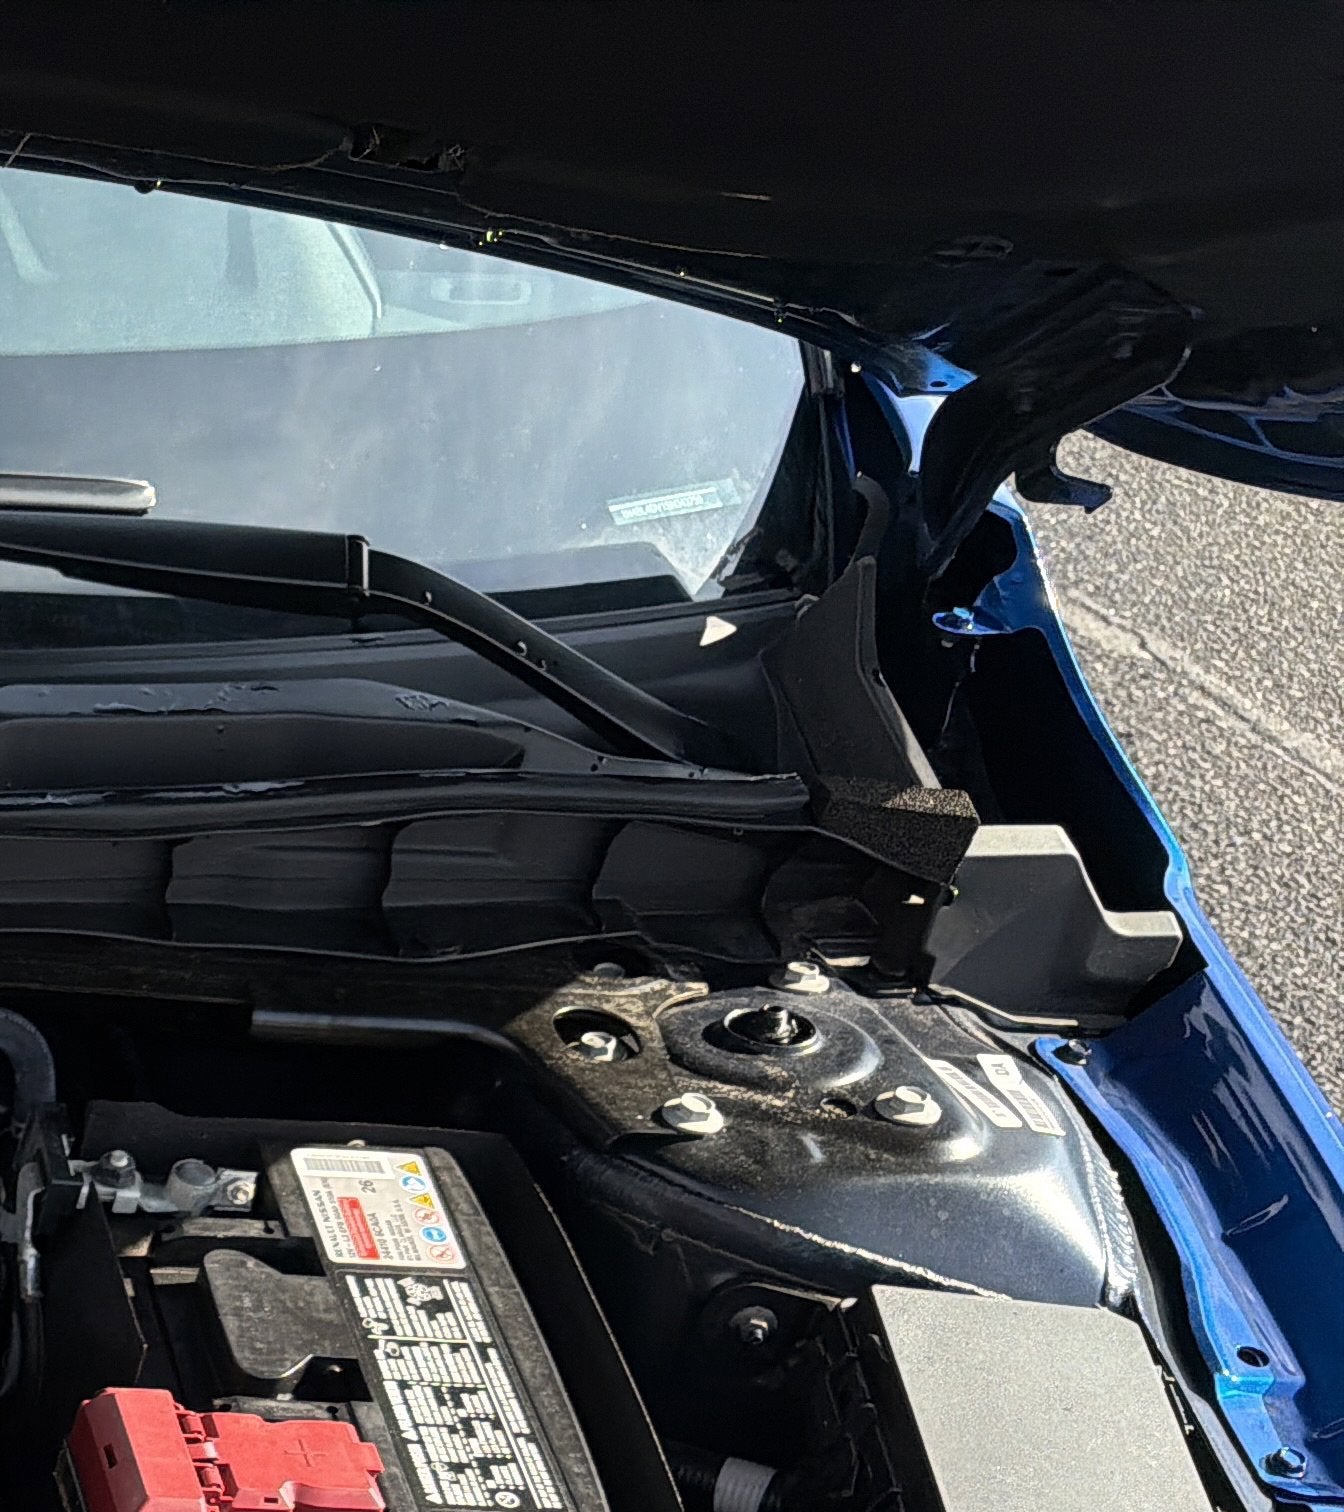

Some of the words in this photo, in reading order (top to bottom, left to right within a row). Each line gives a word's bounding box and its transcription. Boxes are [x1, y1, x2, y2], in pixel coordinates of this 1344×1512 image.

[358, 1179, 376, 1193] 26
[312, 1189, 331, 1223] NISSAN
[325, 1225, 344, 1257] RENAULT
